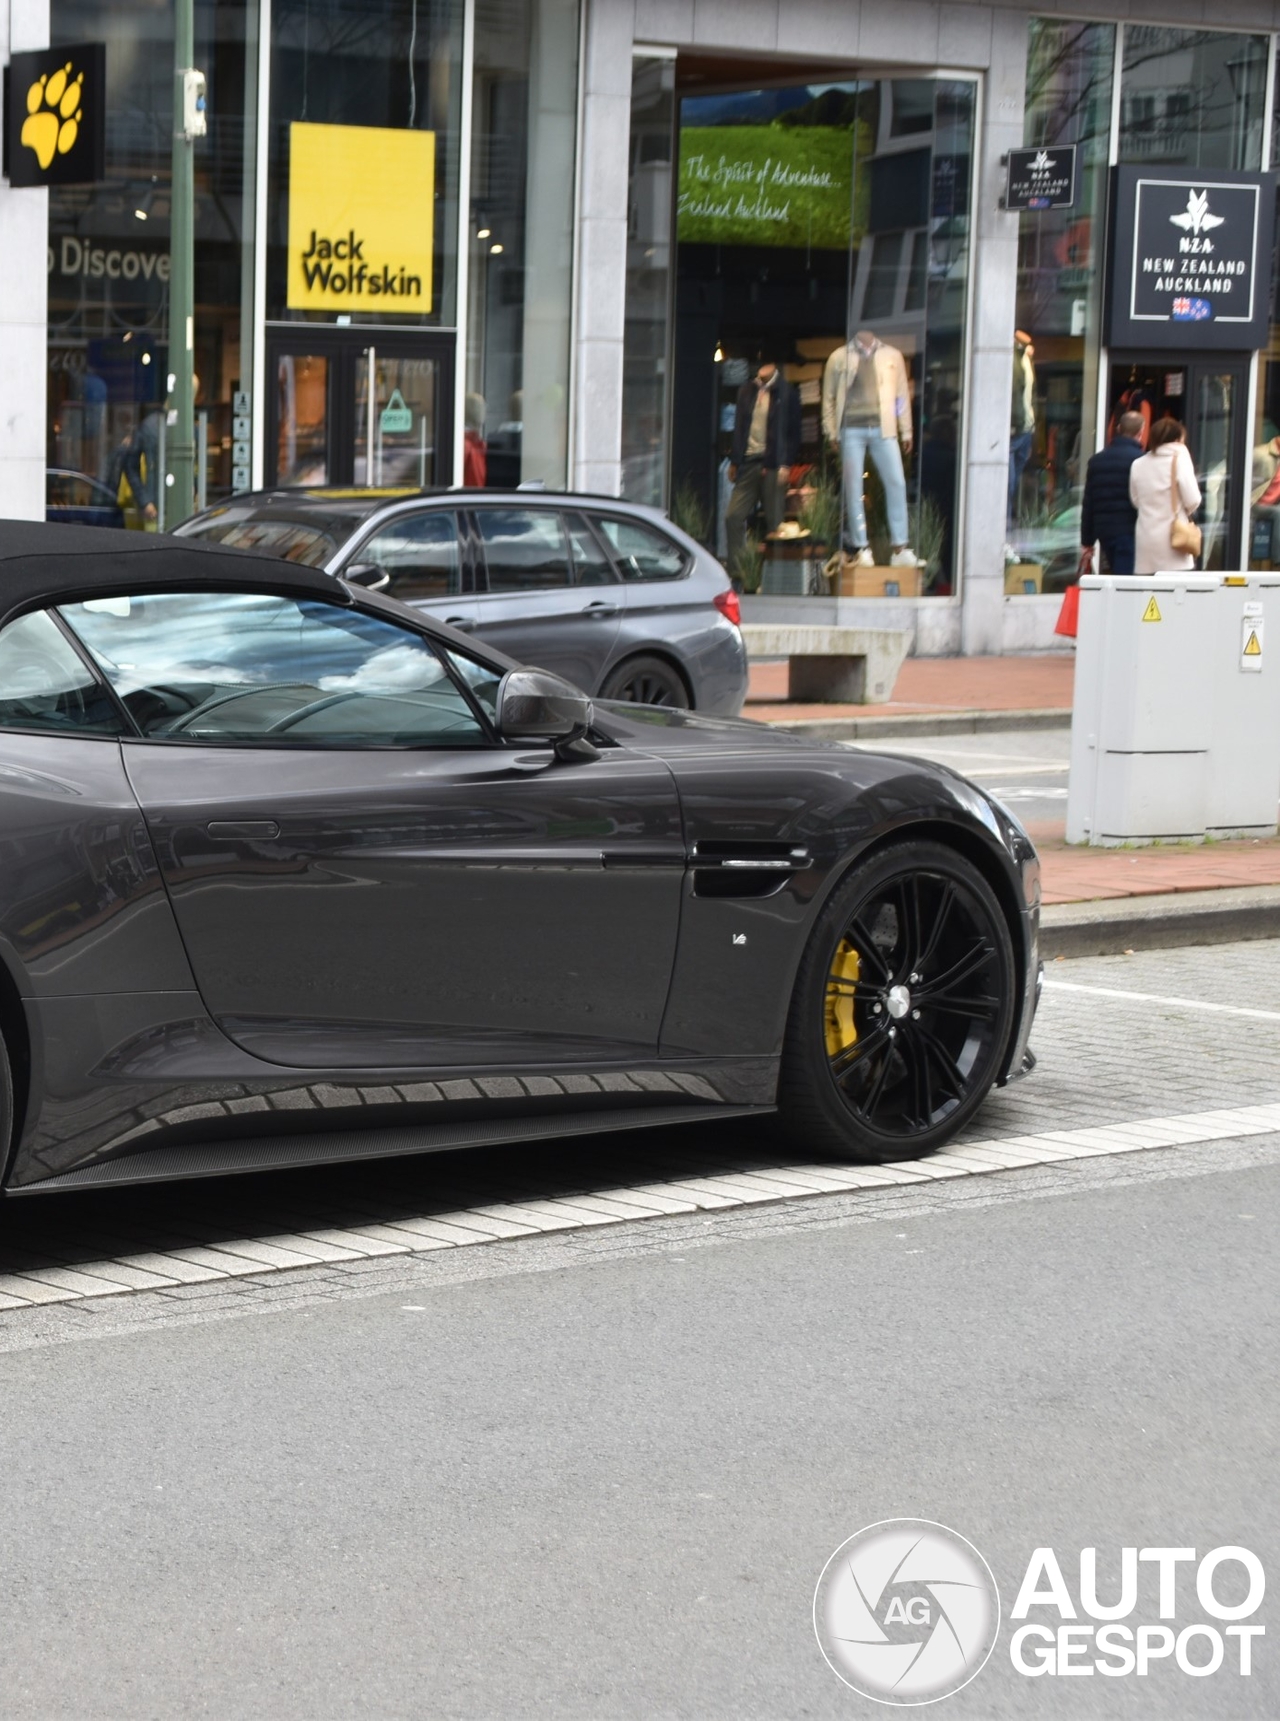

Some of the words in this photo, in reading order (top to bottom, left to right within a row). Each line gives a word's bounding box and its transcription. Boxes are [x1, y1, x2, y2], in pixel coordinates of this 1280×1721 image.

[687, 153, 710, 183] The
[713, 155, 754, 190] Spirit
[756, 157, 771, 198] of
[677, 192, 731, 218] Zealand
[734, 193, 790, 222] Auckland
[61, 235, 171, 281] Discove
[302, 229, 364, 260] Jack
[1179, 237, 1214, 254] NZA
[302, 261, 421, 296] Wolfskin
[1142, 257, 1174, 273] NEW
[1180, 259, 1246, 275] ZEALAND
[1154, 276, 1232, 293] AUCKLAND
